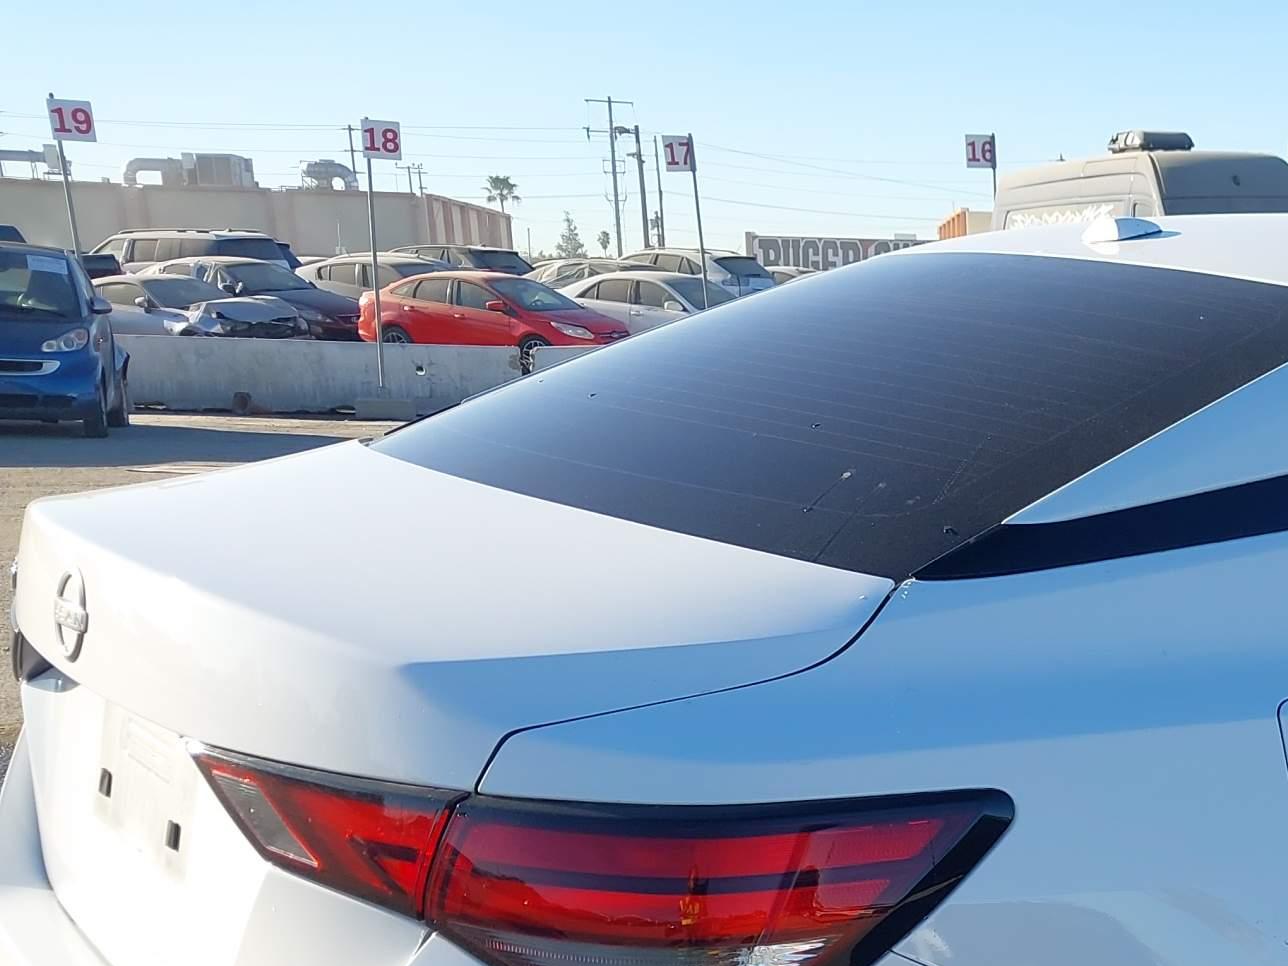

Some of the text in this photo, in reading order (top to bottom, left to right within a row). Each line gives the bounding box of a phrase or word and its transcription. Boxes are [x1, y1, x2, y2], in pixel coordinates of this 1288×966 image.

[50, 107, 92, 134] 19
[363, 127, 399, 153] 18
[967, 140, 993, 163] 16
[664, 142, 690, 165] 17
